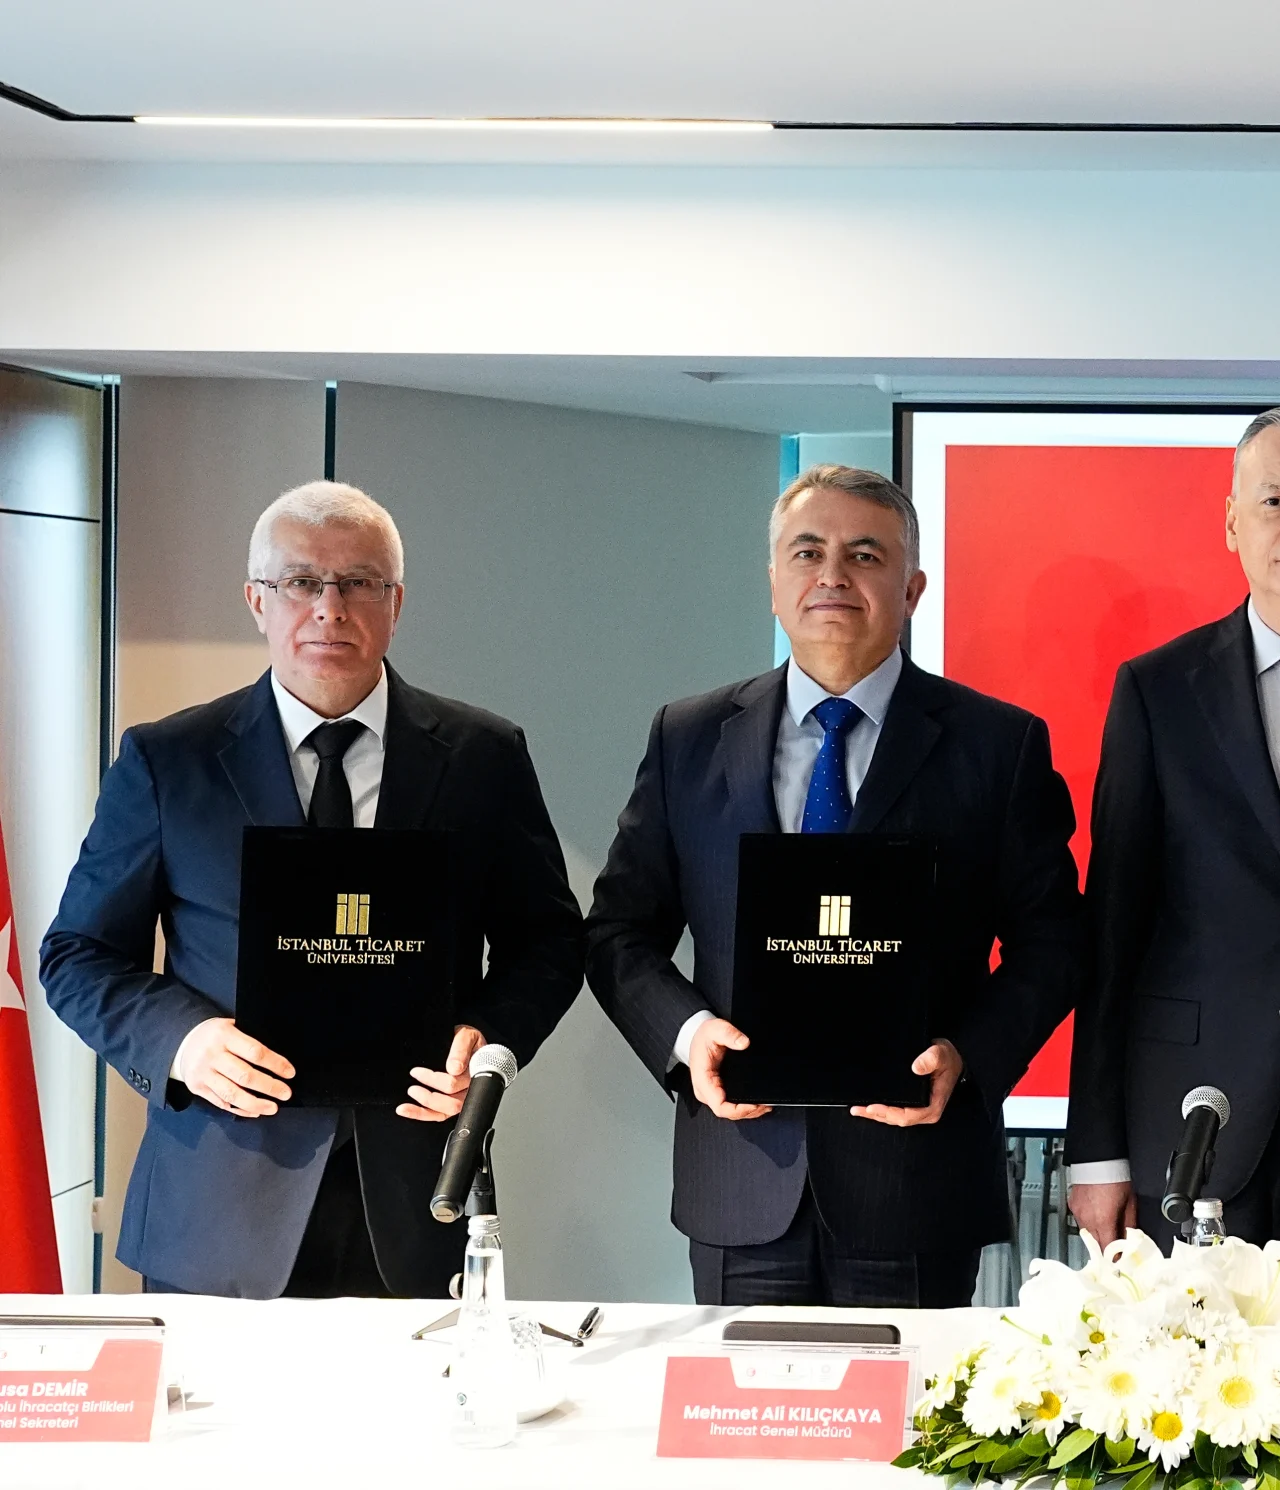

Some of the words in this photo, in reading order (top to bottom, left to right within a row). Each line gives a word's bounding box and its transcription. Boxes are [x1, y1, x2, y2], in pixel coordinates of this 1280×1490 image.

[277, 935, 352, 951] İSTANBUL
[356, 936, 425, 952] TİCARET
[766, 937, 834, 951] İSTANBUL
[838, 937, 902, 953] TİCARET
[307, 952, 395, 965] ÜNİVERSİTESİ
[793, 952, 874, 965] ÜNİVERSİTESİ
[32, 1378, 89, 1397] DEMİR
[19, 1399, 79, 1416] İhracatçı
[82, 1400, 134, 1413] Birlikleri
[684, 1405, 758, 1420] Mehmet
[761, 1406, 784, 1421] Ali
[788, 1407, 882, 1426] KILIÇKAYA
[19, 1416, 79, 1429] Sekreteri
[710, 1422, 757, 1437] İhracat
[760, 1425, 798, 1437] Genel
[802, 1424, 852, 1438] Müdürü
